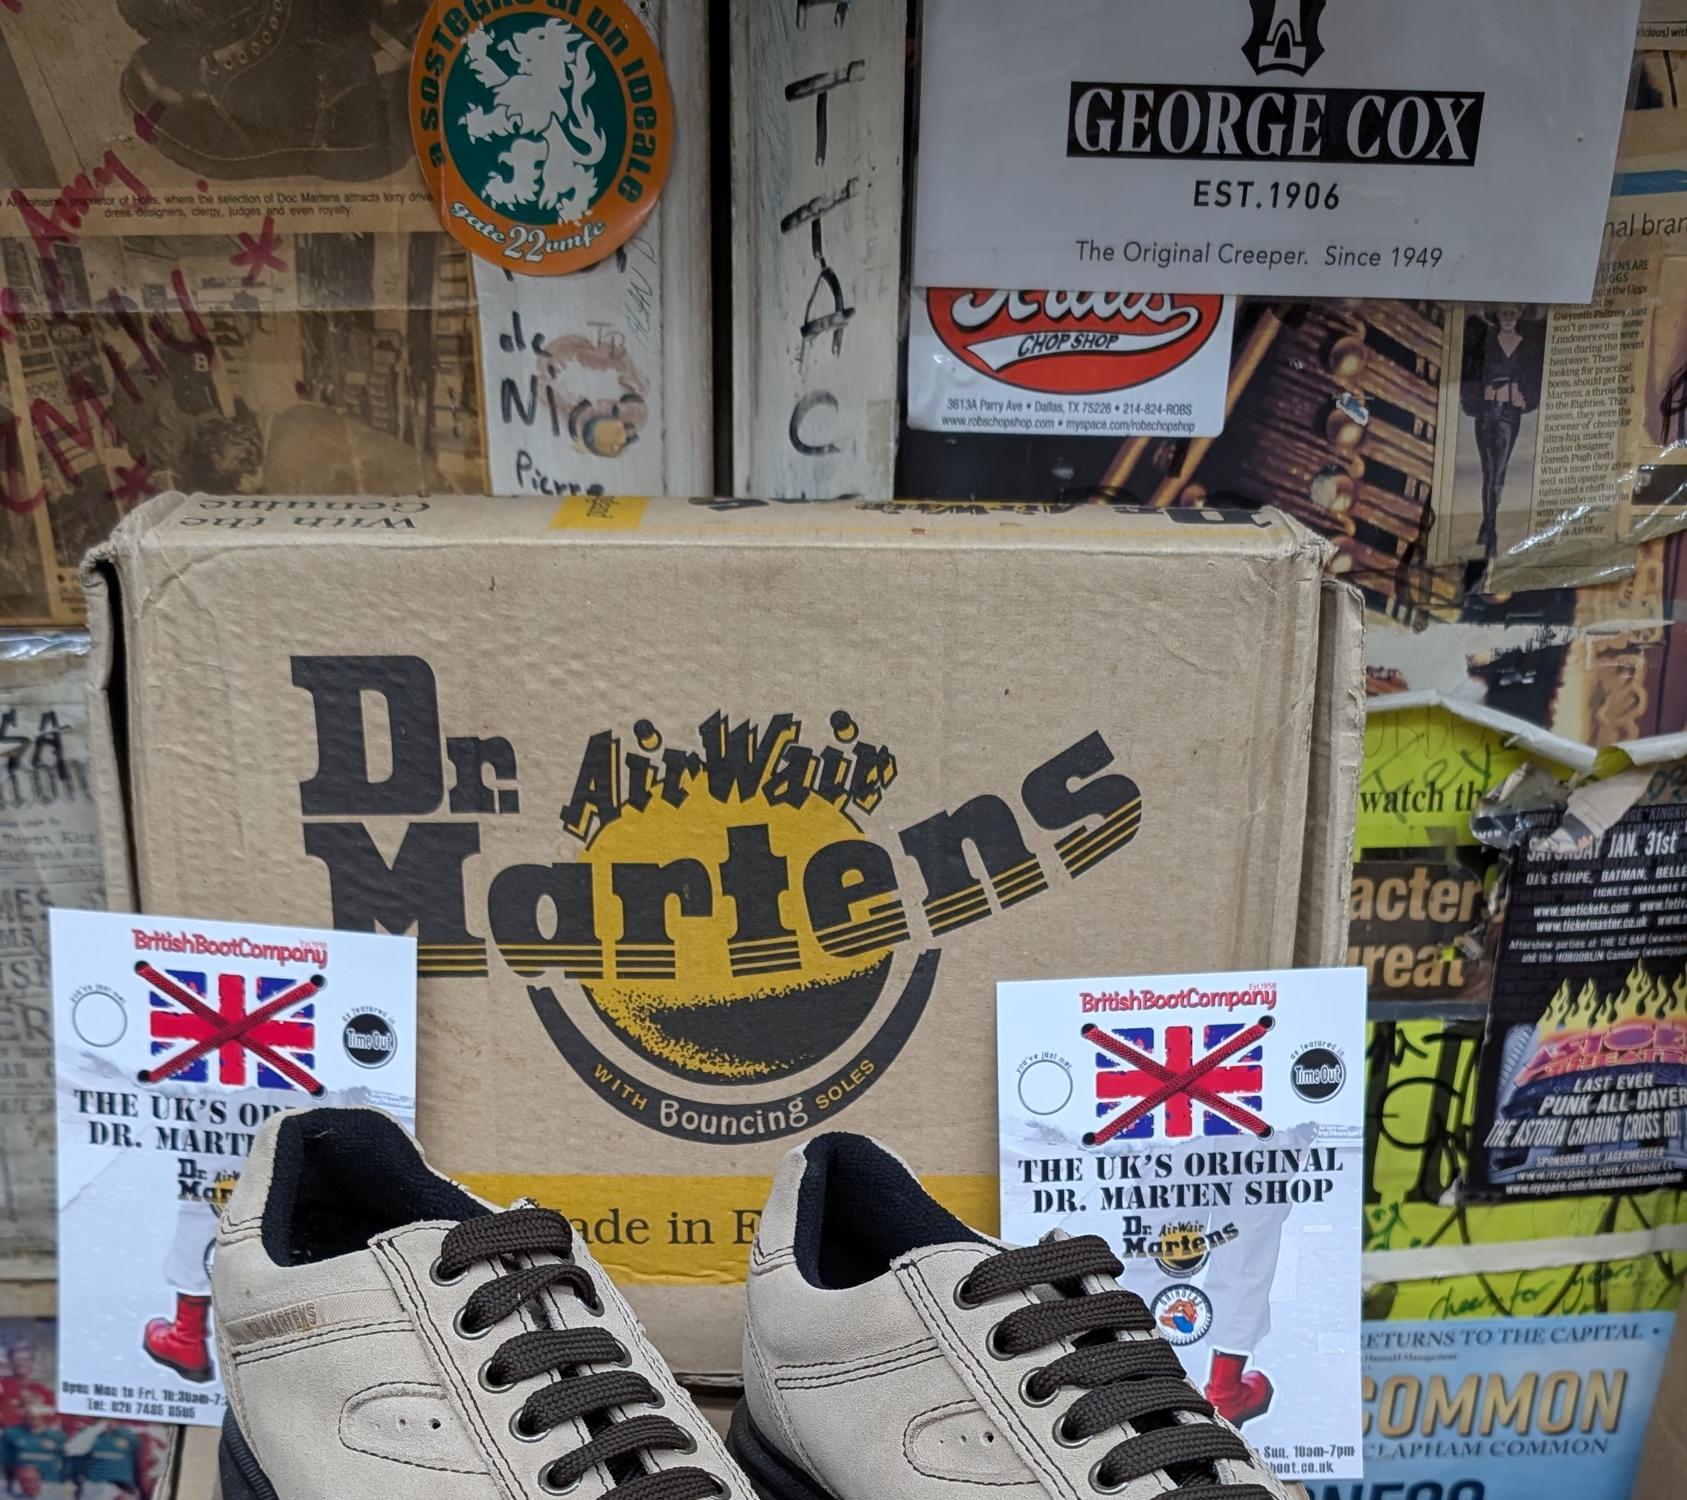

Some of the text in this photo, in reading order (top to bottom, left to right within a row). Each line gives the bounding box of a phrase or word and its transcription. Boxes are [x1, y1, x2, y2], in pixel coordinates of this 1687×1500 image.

[1074, 88, 1477, 161] GEORGE COX
[104, 206, 132, 218] dress
[229, 205, 262, 217] judges
[266, 204, 285, 216] and
[289, 205, 314, 216] even
[1194, 180, 1341, 211] EST.1906
[503, 224, 547, 263] 22
[1075, 240, 1443, 271] The Original Creeper. Since 1949
[1017, 333, 1119, 358] CHOP SHOP
[979, 399, 1003, 415] Parry
[1005, 400, 1024, 412] Ave
[1067, 402, 1079, 413] TX
[178, 514, 419, 530] With the
[291, 655, 518, 816] Dr.
[562, 711, 898, 847] AirWair
[1360, 780, 1444, 814] watch
[305, 730, 1143, 981] Martens
[1607, 829, 1680, 859] JAN. 31st
[132, 928, 328, 970] BritishBootCompany
[1079, 986, 1277, 1014] BritishBootCompany
[592, 1058, 875, 1136] WITH Bouncing SOLES
[1573, 1072, 1655, 1093] LAST EVER
[74, 1088, 139, 1118] THE
[150, 1094, 228, 1127] UK'S
[1537, 1093, 1594, 1116] PUNK
[88, 1120, 143, 1149] DR.
[1567, 1114, 1623, 1147] CHARING
[1622, 1111, 1661, 1142] CROSS
[1017, 1146, 1344, 1184] THE UK'S ORIGINAL
[1033, 1178, 1334, 1214] DR. MARTEN SHOP
[556, 1208, 651, 1246] ade
[667, 1211, 715, 1245] in
[1122, 1221, 1240, 1258] Martens
[1460, 1329, 1493, 1347] TO
[1498, 1327, 1546, 1345] THE
[1550, 1322, 1643, 1347] CAPITAL
[121, 1385, 135, 1399] to
[1489, 1437, 1609, 1458] COMMON
